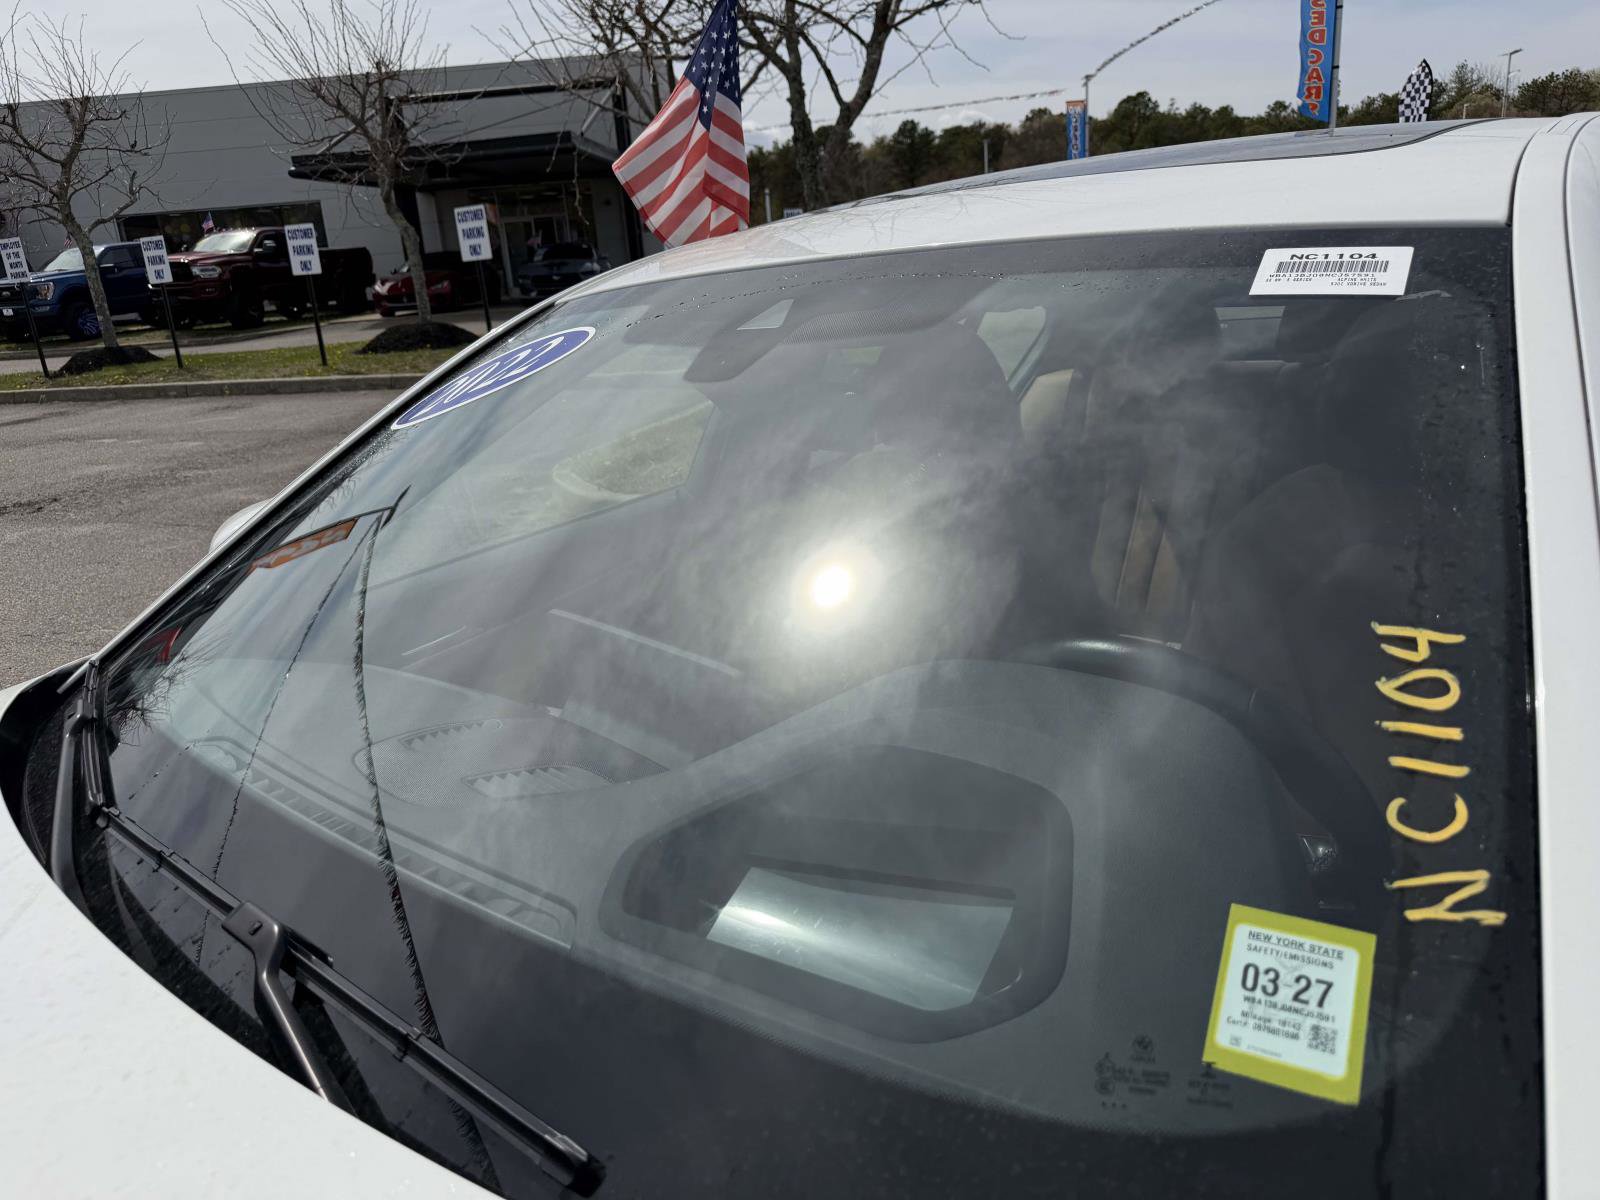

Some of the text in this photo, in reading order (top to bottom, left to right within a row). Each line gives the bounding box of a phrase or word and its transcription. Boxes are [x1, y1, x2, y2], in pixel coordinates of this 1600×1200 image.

[457, 209, 483, 223] CUSTOMER
[287, 228, 313, 240] CUSTOMER
[462, 226, 484, 239] PARKING
[142, 240, 164, 251] CUSTOMER
[293, 244, 314, 256] PARKING
[469, 244, 481, 257] ONLY
[147, 254, 165, 266] PARKING
[300, 260, 312, 272] ONLY
[10, 270, 28, 279] PARKING
[154, 269, 164, 280] ONLY
[409, 336, 564, 420] 2022
[1371, 621, 1507, 925] NC1104
[1248, 930, 1344, 960] NEW YORK STATE
[1246, 943, 1334, 970] SAFETY/EMISSIONS
[1241, 963, 1334, 1008] 03 27
